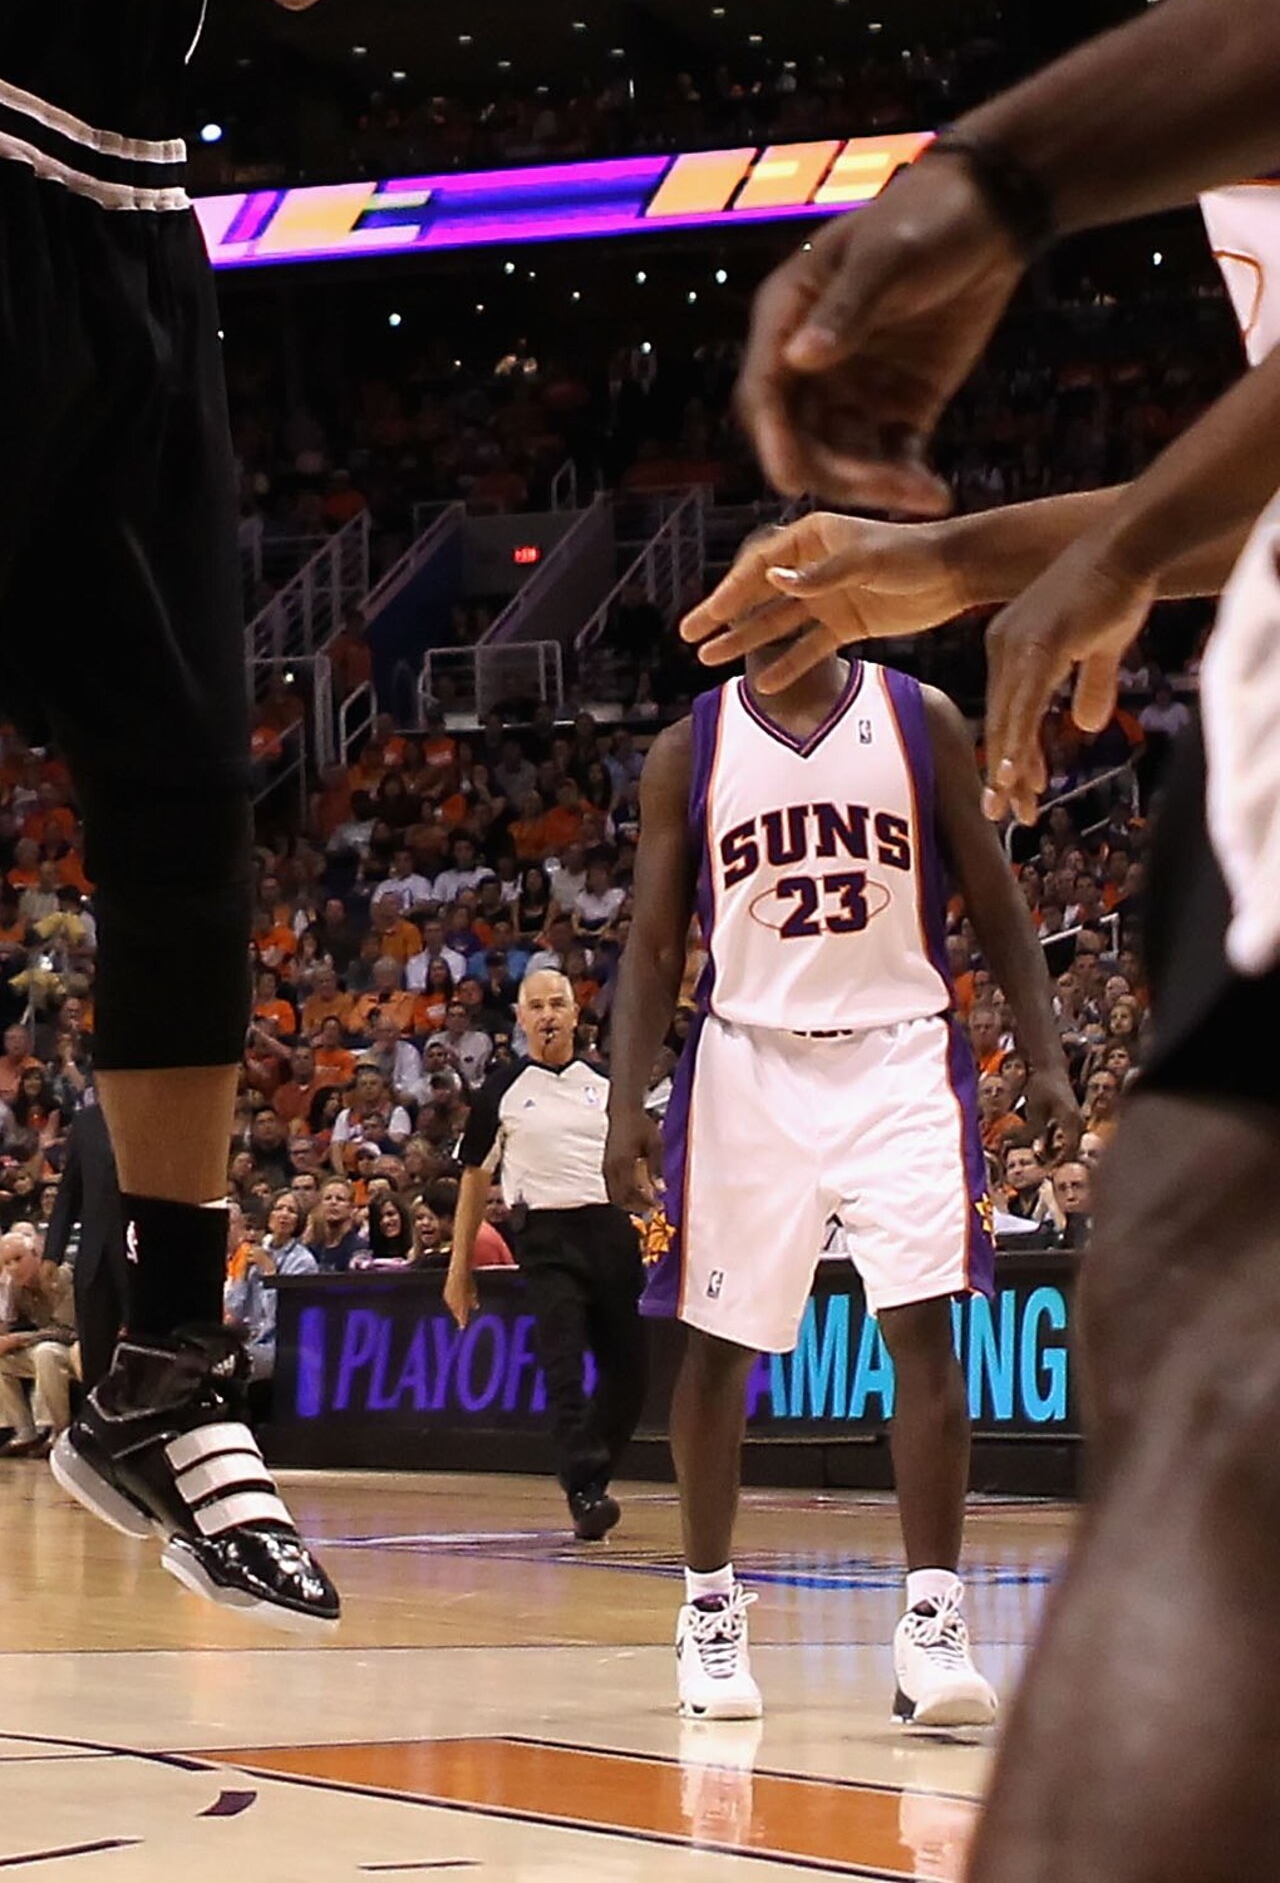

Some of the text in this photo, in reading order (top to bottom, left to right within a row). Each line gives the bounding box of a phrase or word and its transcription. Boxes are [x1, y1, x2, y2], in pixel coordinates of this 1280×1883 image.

[720, 802, 912, 891] SUNS
[776, 869, 869, 940] 23
[331, 1307, 600, 1413] PLAYOF
